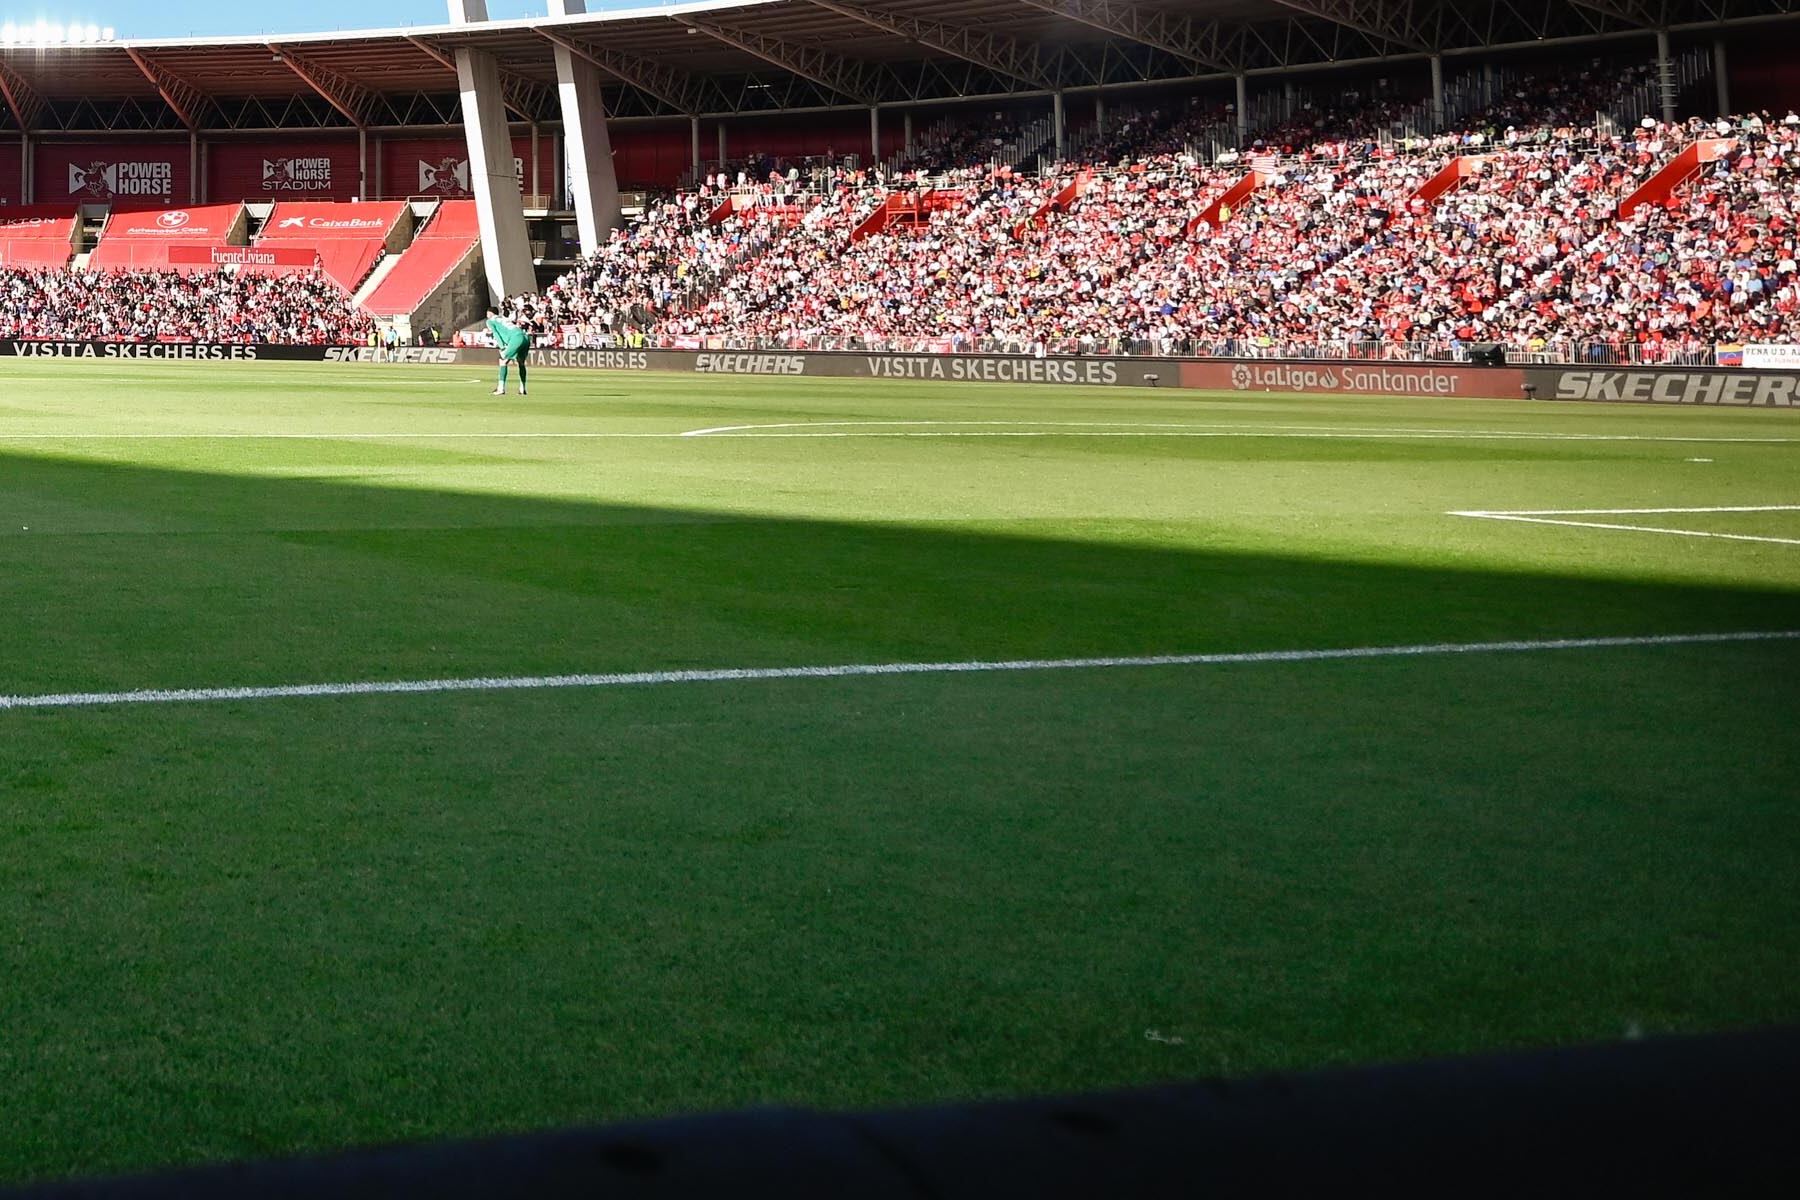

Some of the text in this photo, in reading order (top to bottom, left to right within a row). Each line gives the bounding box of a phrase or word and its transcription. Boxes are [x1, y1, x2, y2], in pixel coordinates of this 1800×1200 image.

[118, 162, 172, 179] POWER
[295, 158, 331, 169] POWER
[295, 168, 331, 180] HORSE
[118, 178, 172, 195] HORSE
[262, 180, 331, 191] STADIUM
[309, 217, 384, 228] CaixaBank
[211, 247, 276, 265] FuenteLiviana
[12, 341, 257, 361] VISITA SKECHERS.ES
[549, 350, 647, 369] SKECHERS.ES
[695, 353, 805, 375] SKECHERS
[867, 356, 1118, 385] VISITA SKECHERS.ES
[1254, 366, 1459, 393] LaLiga Santander
